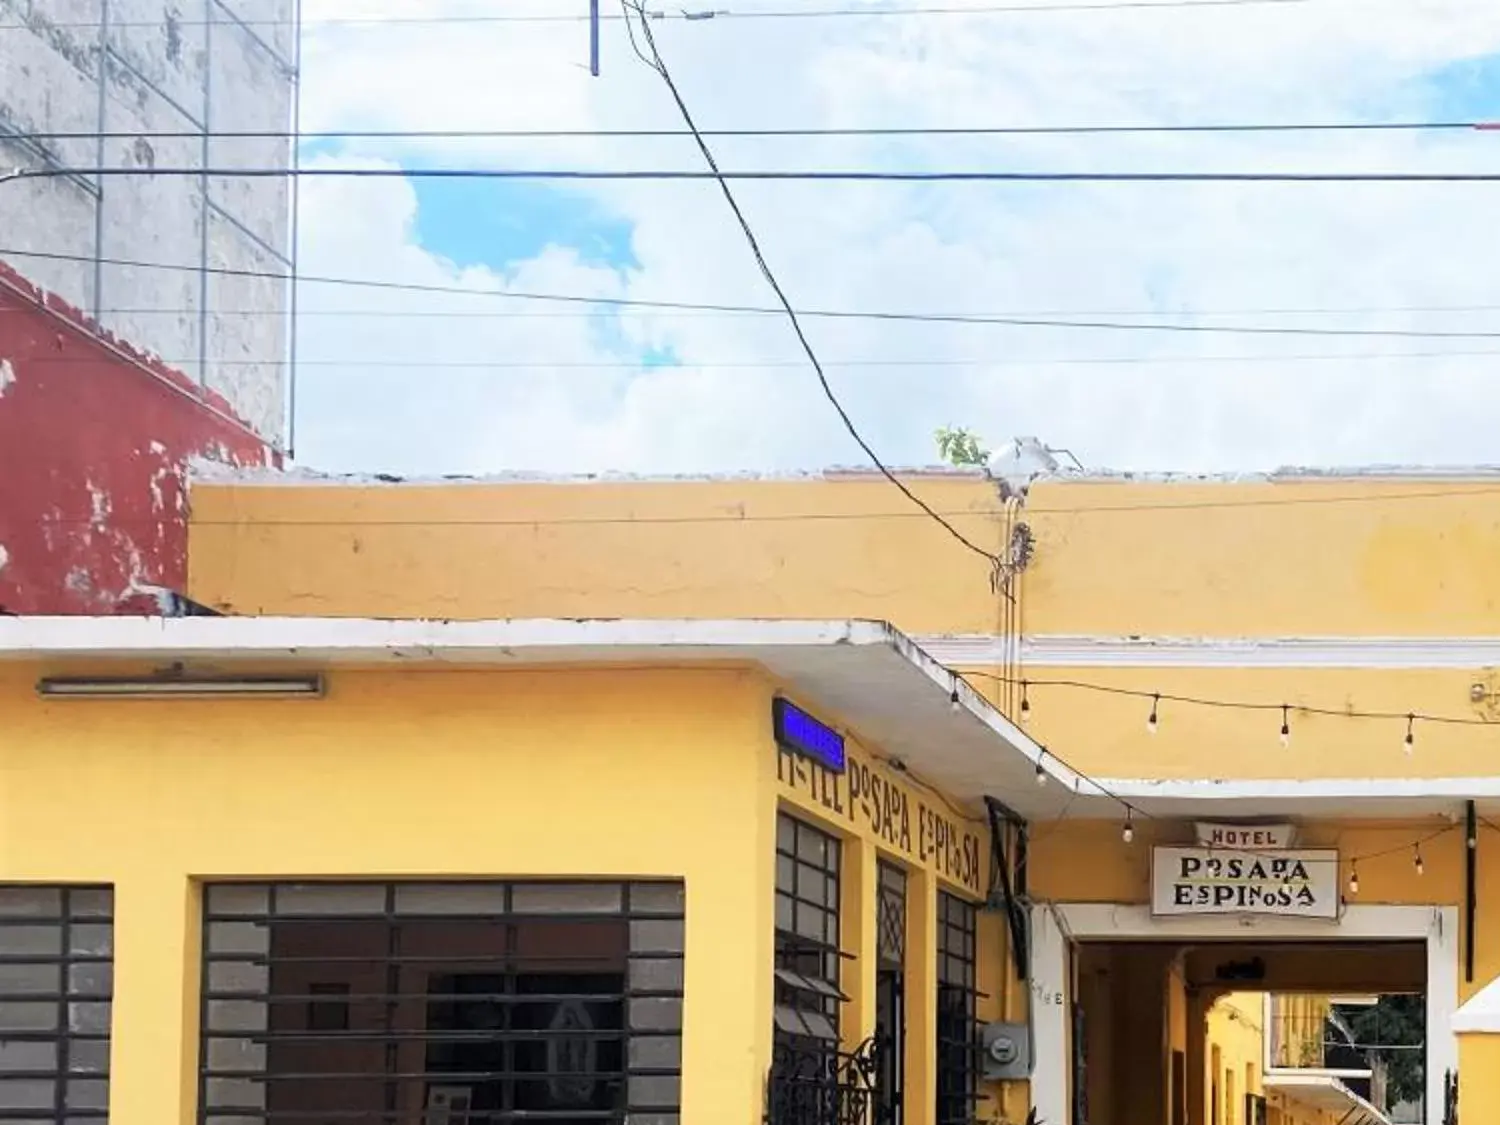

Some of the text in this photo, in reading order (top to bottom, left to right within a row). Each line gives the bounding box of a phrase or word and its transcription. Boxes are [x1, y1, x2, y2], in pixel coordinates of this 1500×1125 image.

[1211, 828, 1278, 845] HOTEL
[1180, 857, 1310, 880] POSADA
[1173, 884, 1316, 907] ESPINOSA
